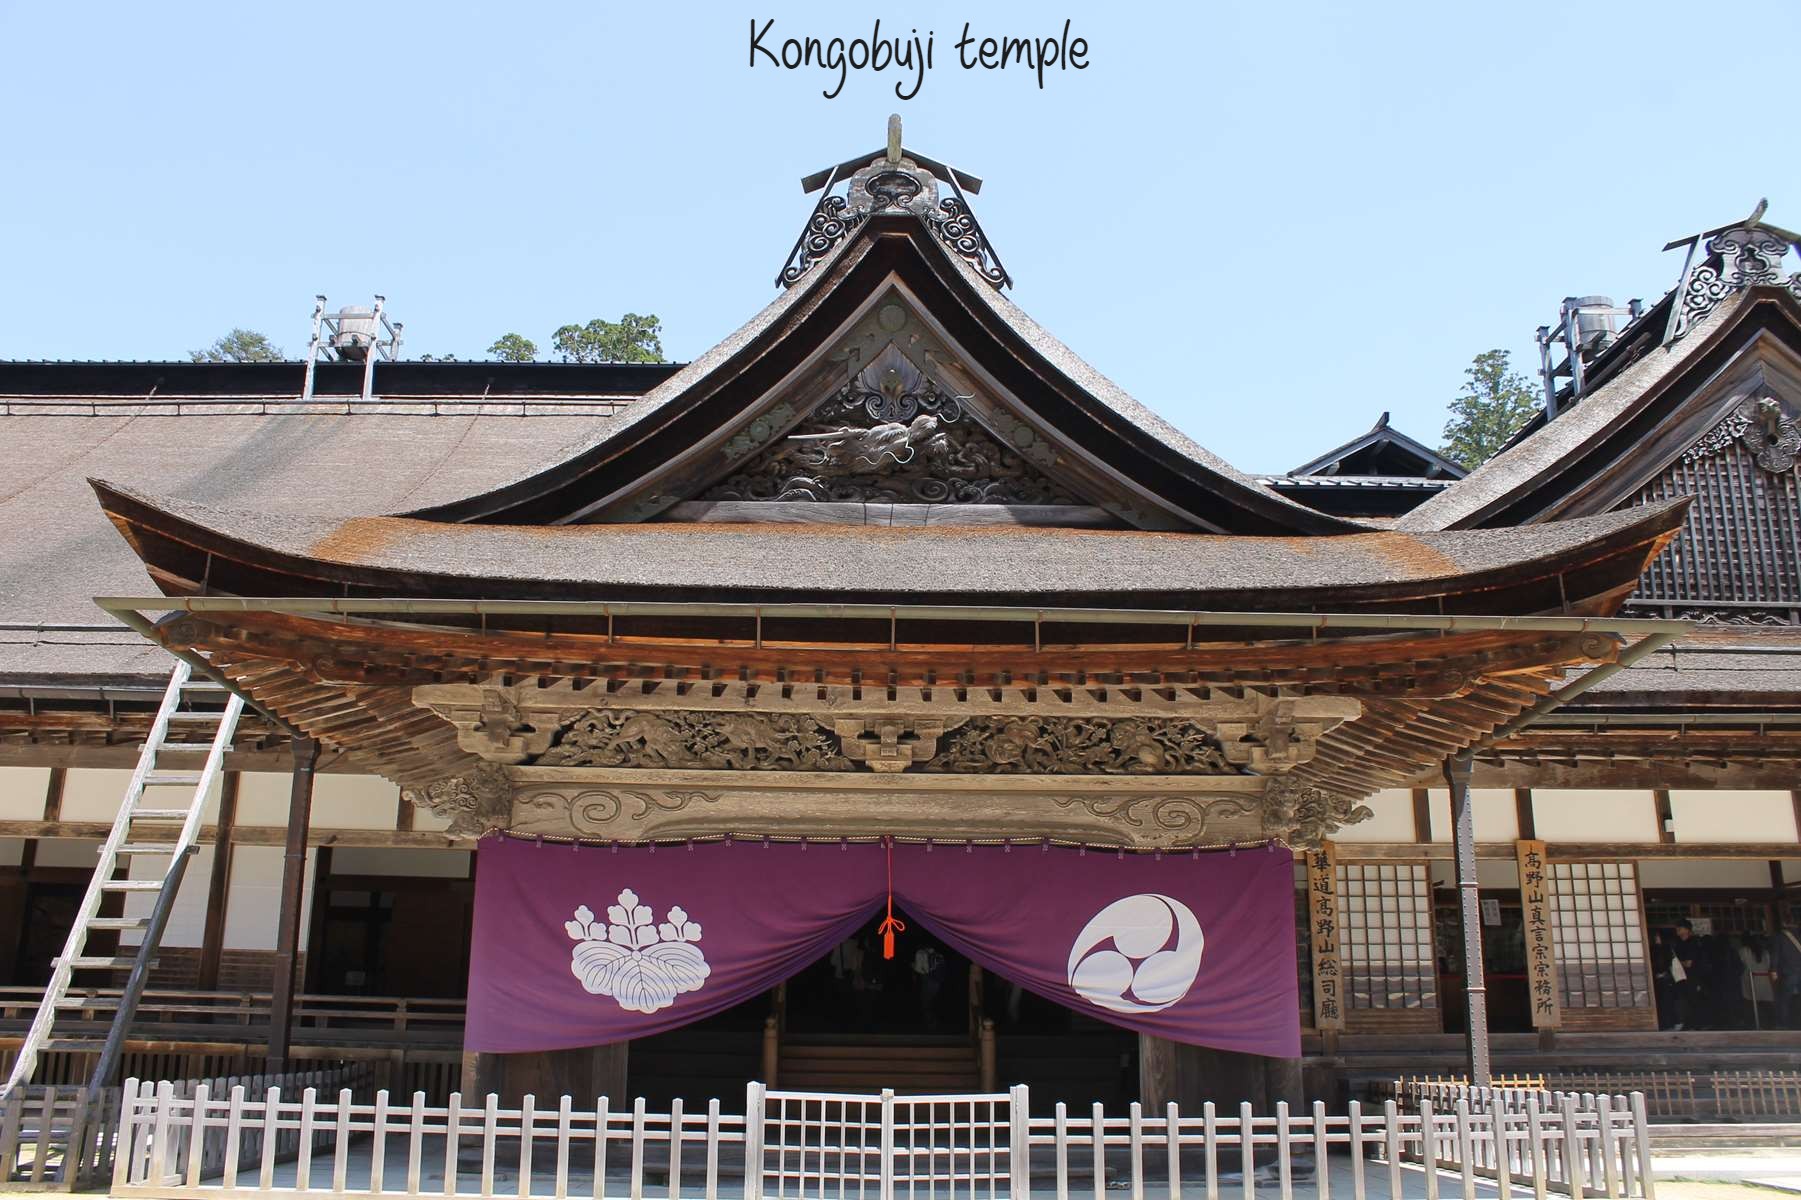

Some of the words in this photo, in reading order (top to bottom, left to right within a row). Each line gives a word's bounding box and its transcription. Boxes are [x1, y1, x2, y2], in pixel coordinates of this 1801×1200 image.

[1524, 844, 1553, 1016] 高野山真言宗宗務所
